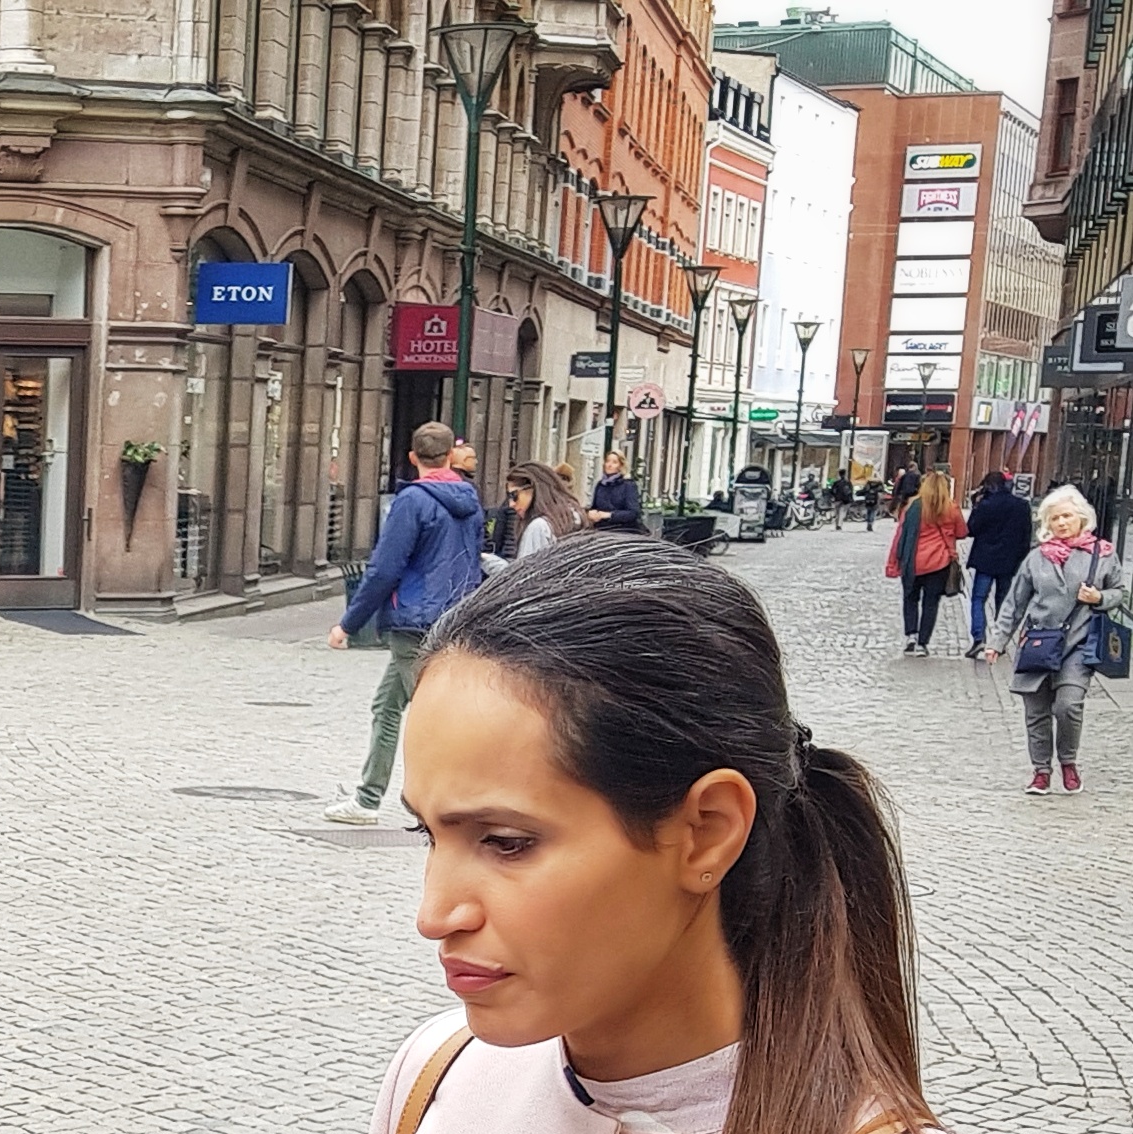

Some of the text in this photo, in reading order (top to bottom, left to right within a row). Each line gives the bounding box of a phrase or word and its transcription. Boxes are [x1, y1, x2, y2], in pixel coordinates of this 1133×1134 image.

[911, 154, 974, 170] SUBWAY
[211, 286, 274, 301] ETON
[410, 340, 459, 353] HOTEL
